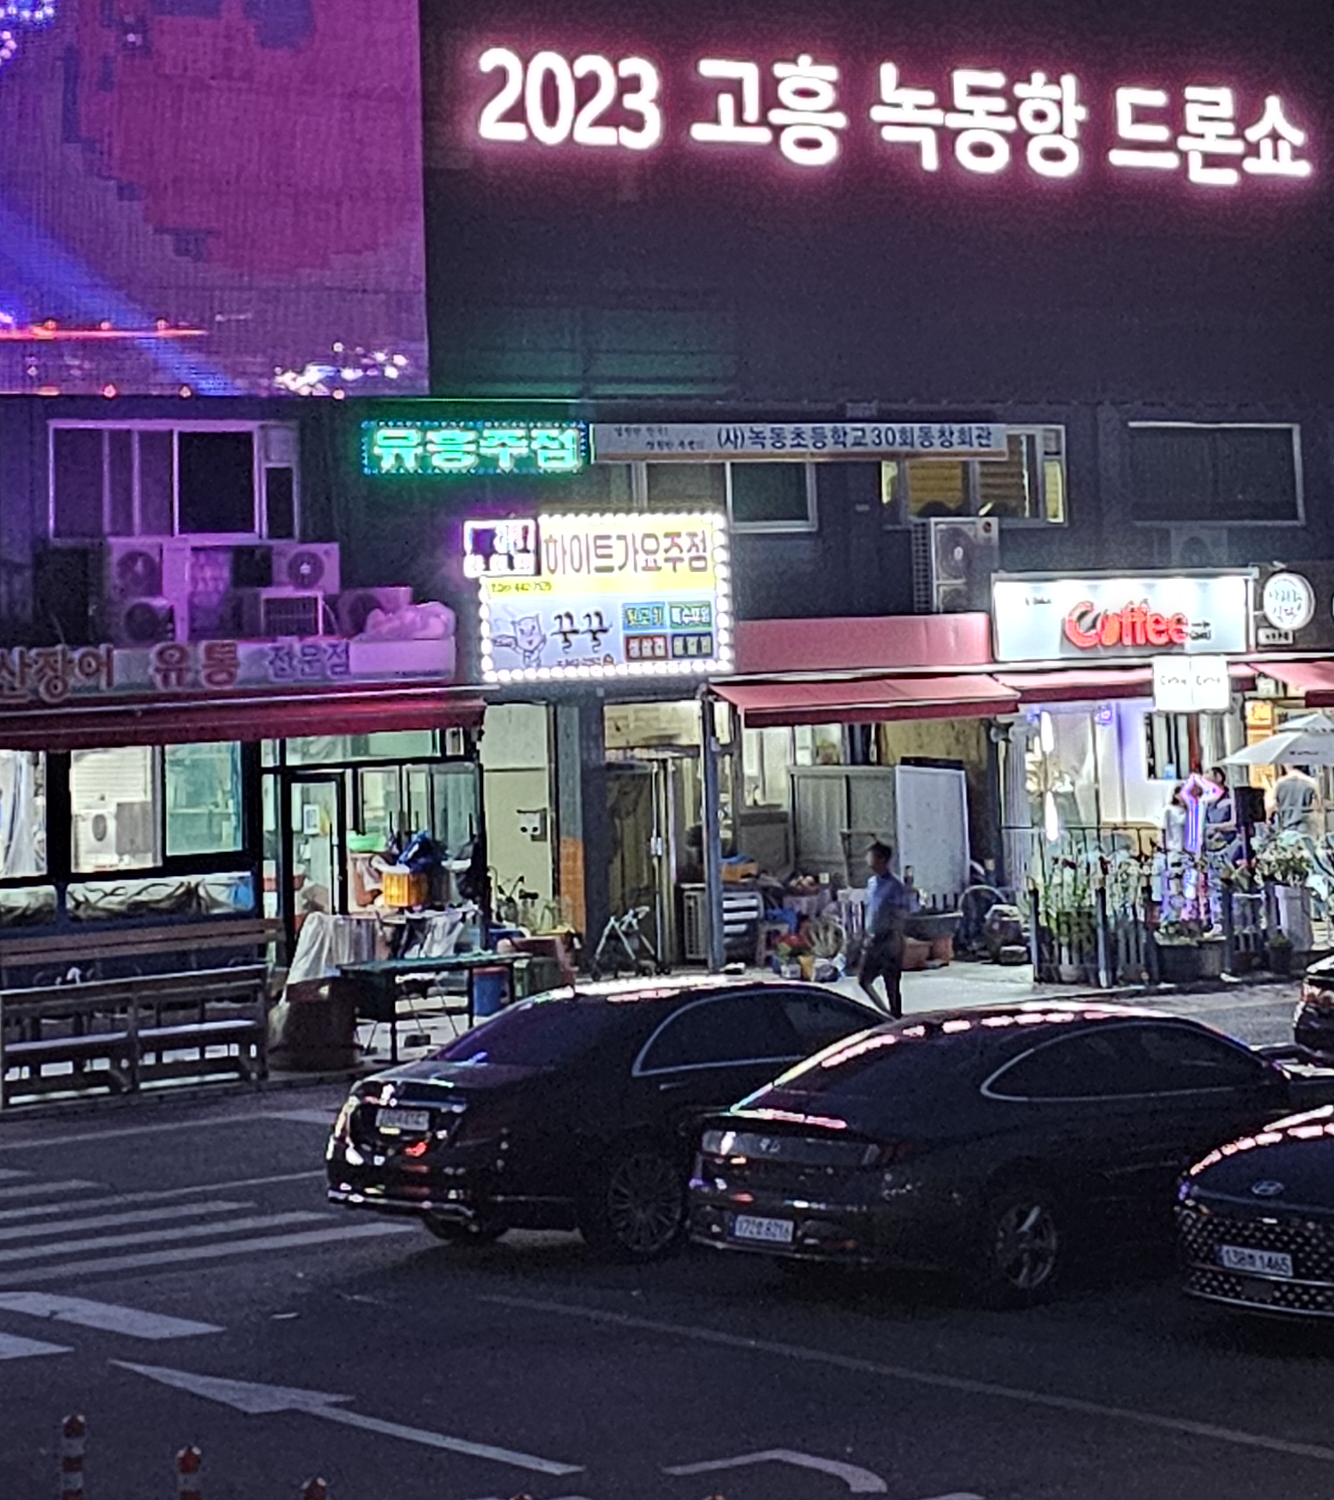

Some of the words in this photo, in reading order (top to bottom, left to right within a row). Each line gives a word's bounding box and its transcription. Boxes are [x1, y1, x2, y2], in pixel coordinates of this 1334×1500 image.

[478, 47, 663, 150] 2023
[689, 55, 848, 167] 고흥
[869, 62, 1087, 178] 녹동항
[1107, 86, 1313, 186] 드론쇼
[372, 429, 582, 473] 유흥주점
[544, 530, 709, 576] 하이트가요주점
[1064, 599, 1189, 648] Coffee
[150, 640, 239, 689] 유통
[268, 640, 351, 680] 전문점
